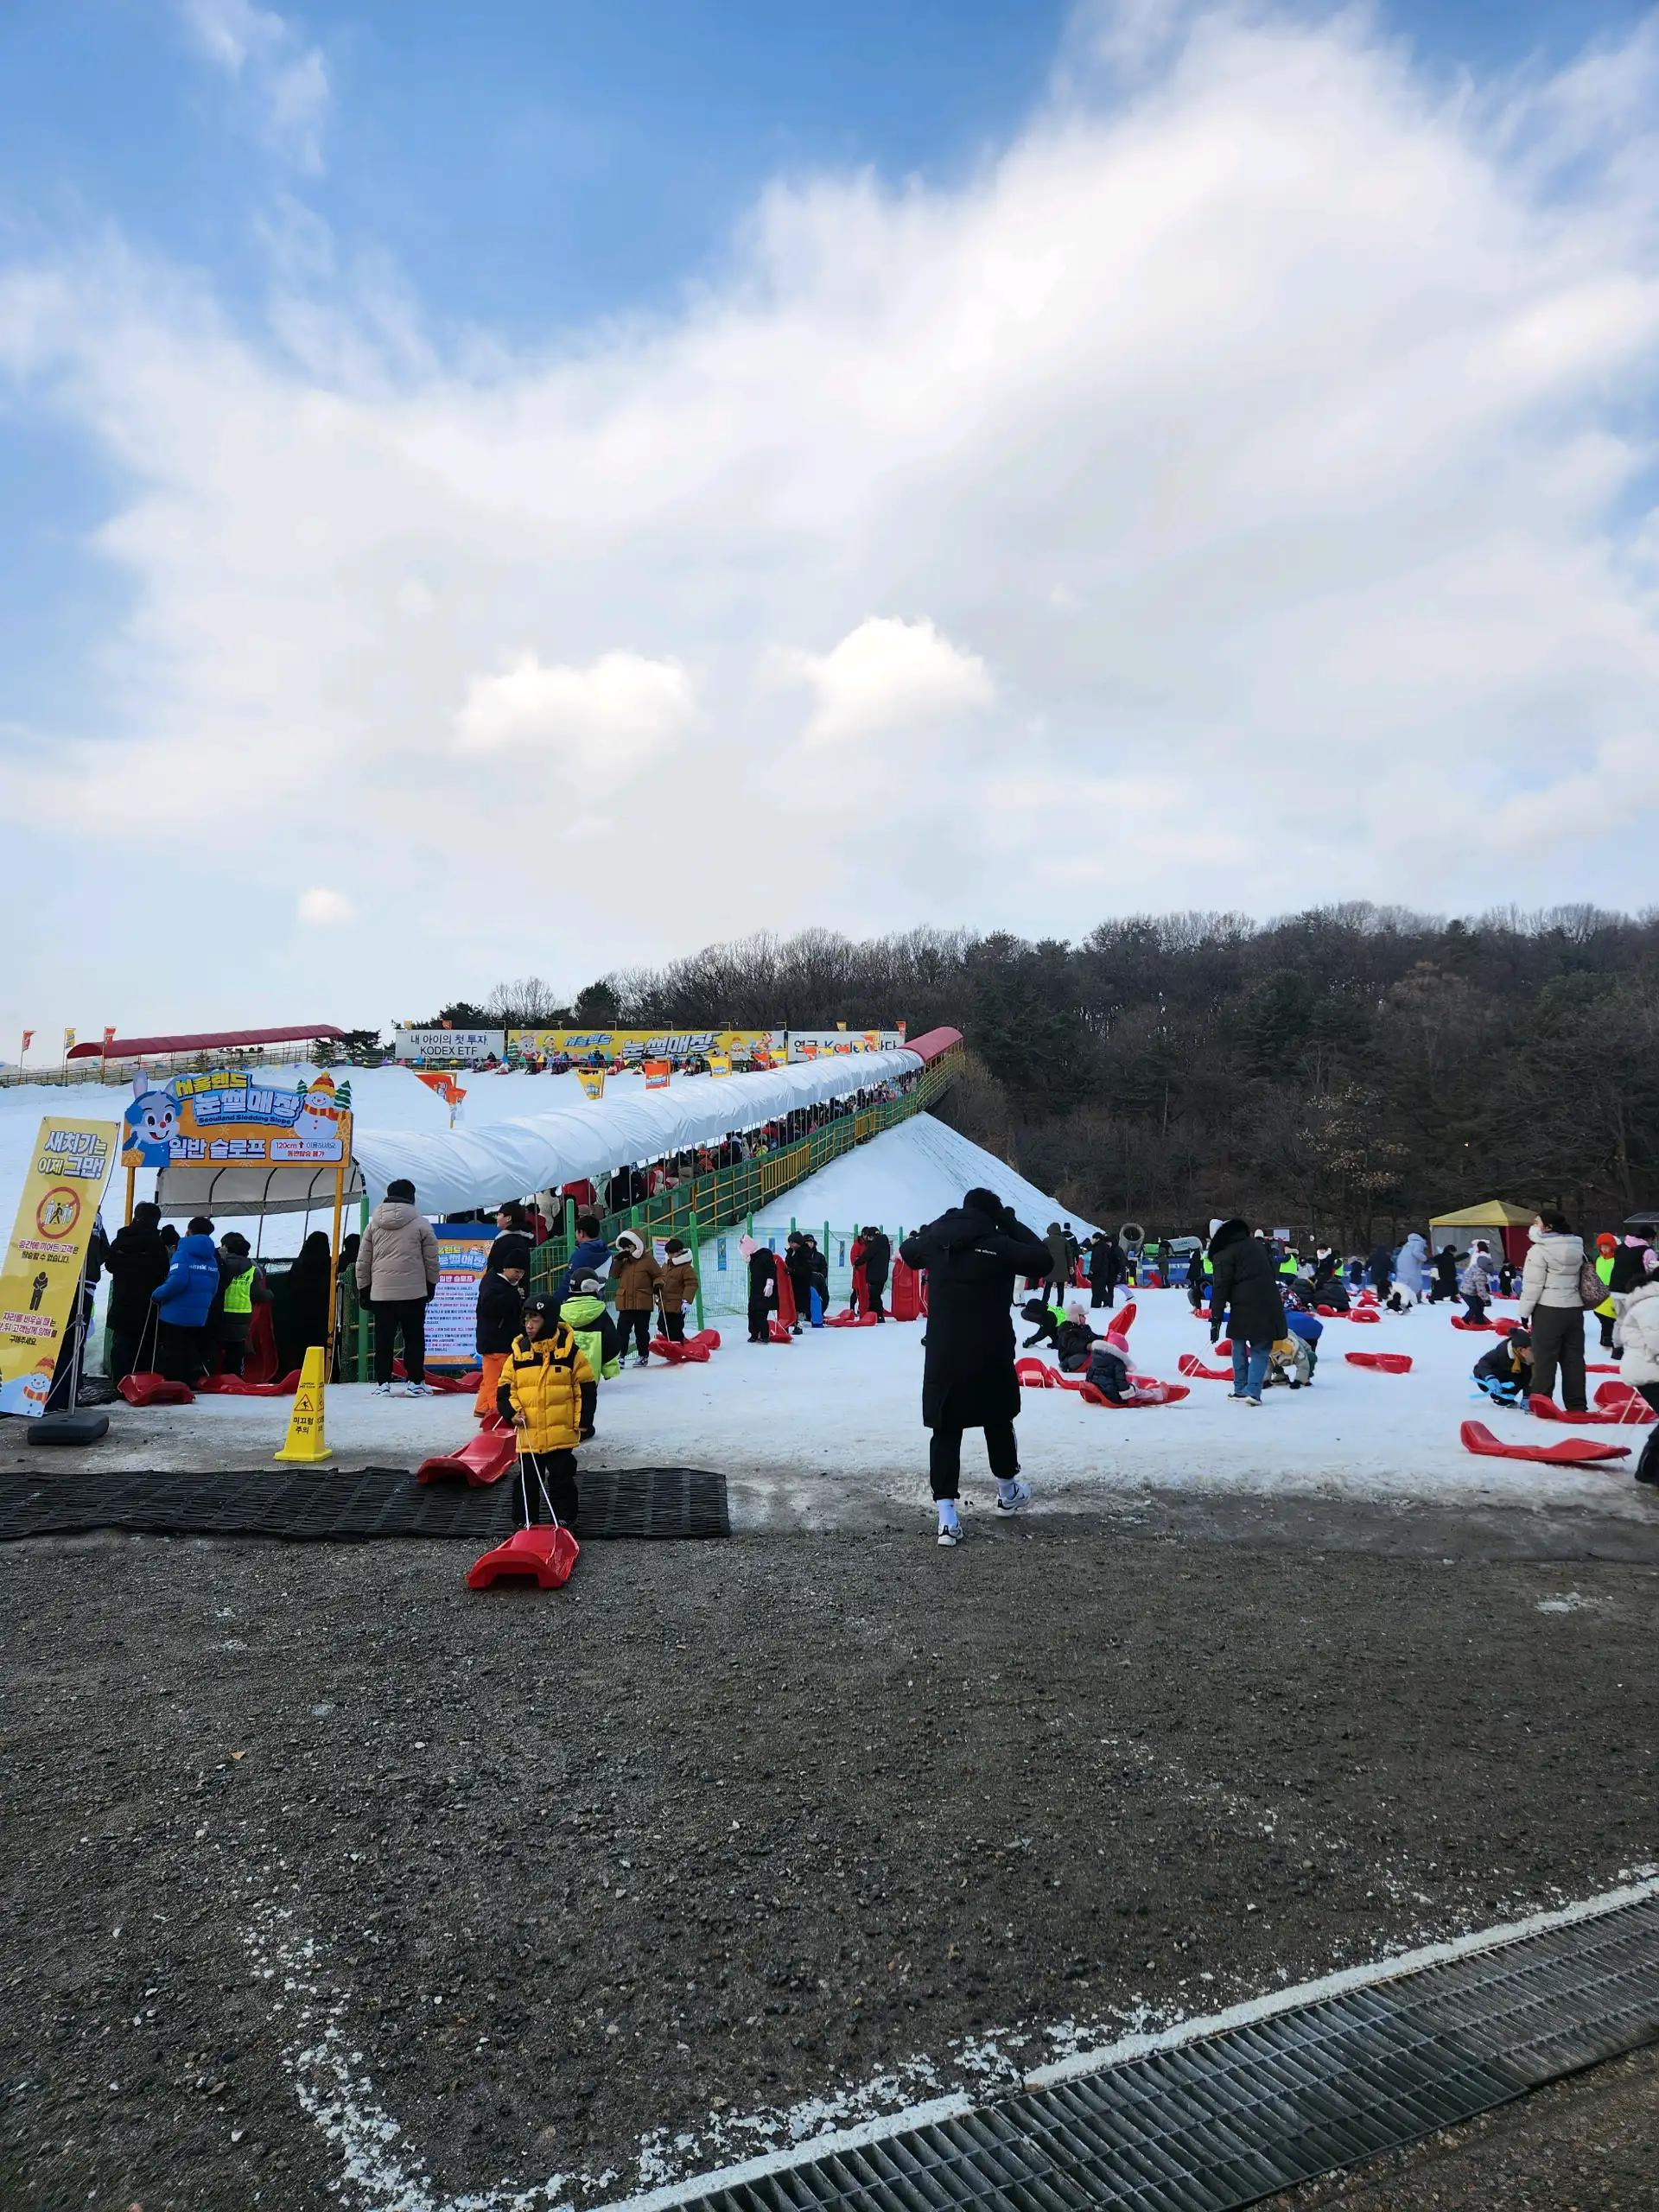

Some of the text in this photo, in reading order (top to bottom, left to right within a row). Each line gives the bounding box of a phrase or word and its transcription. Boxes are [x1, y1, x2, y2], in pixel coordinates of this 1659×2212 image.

[410, 1034, 420, 1045] 내
[423, 1034, 452, 1045] 아이의
[454, 1034, 465, 1045] 첫
[420, 1046, 478, 1055] KODEX ETF
[622, 1033, 722, 1059] 눈썰매장
[175, 1071, 250, 1097] 서울랜드
[194, 1089, 301, 1118] 눈썰매장
[198, 1114, 291, 1125] Seoulland Sledding Slope
[44, 1130, 108, 1156] 새치기는
[168, 1138, 266, 1160] 일반 슬로프
[38, 1154, 105, 1180] 이제 그만!
[60, 1244, 79, 1255] 고객은
[3, 1313, 23, 1323] 자리를
[23, 1315, 42, 1325] 비우실
[294, 1417, 314, 1426] 미끄럼
[296, 1426, 309, 1434] 주의
